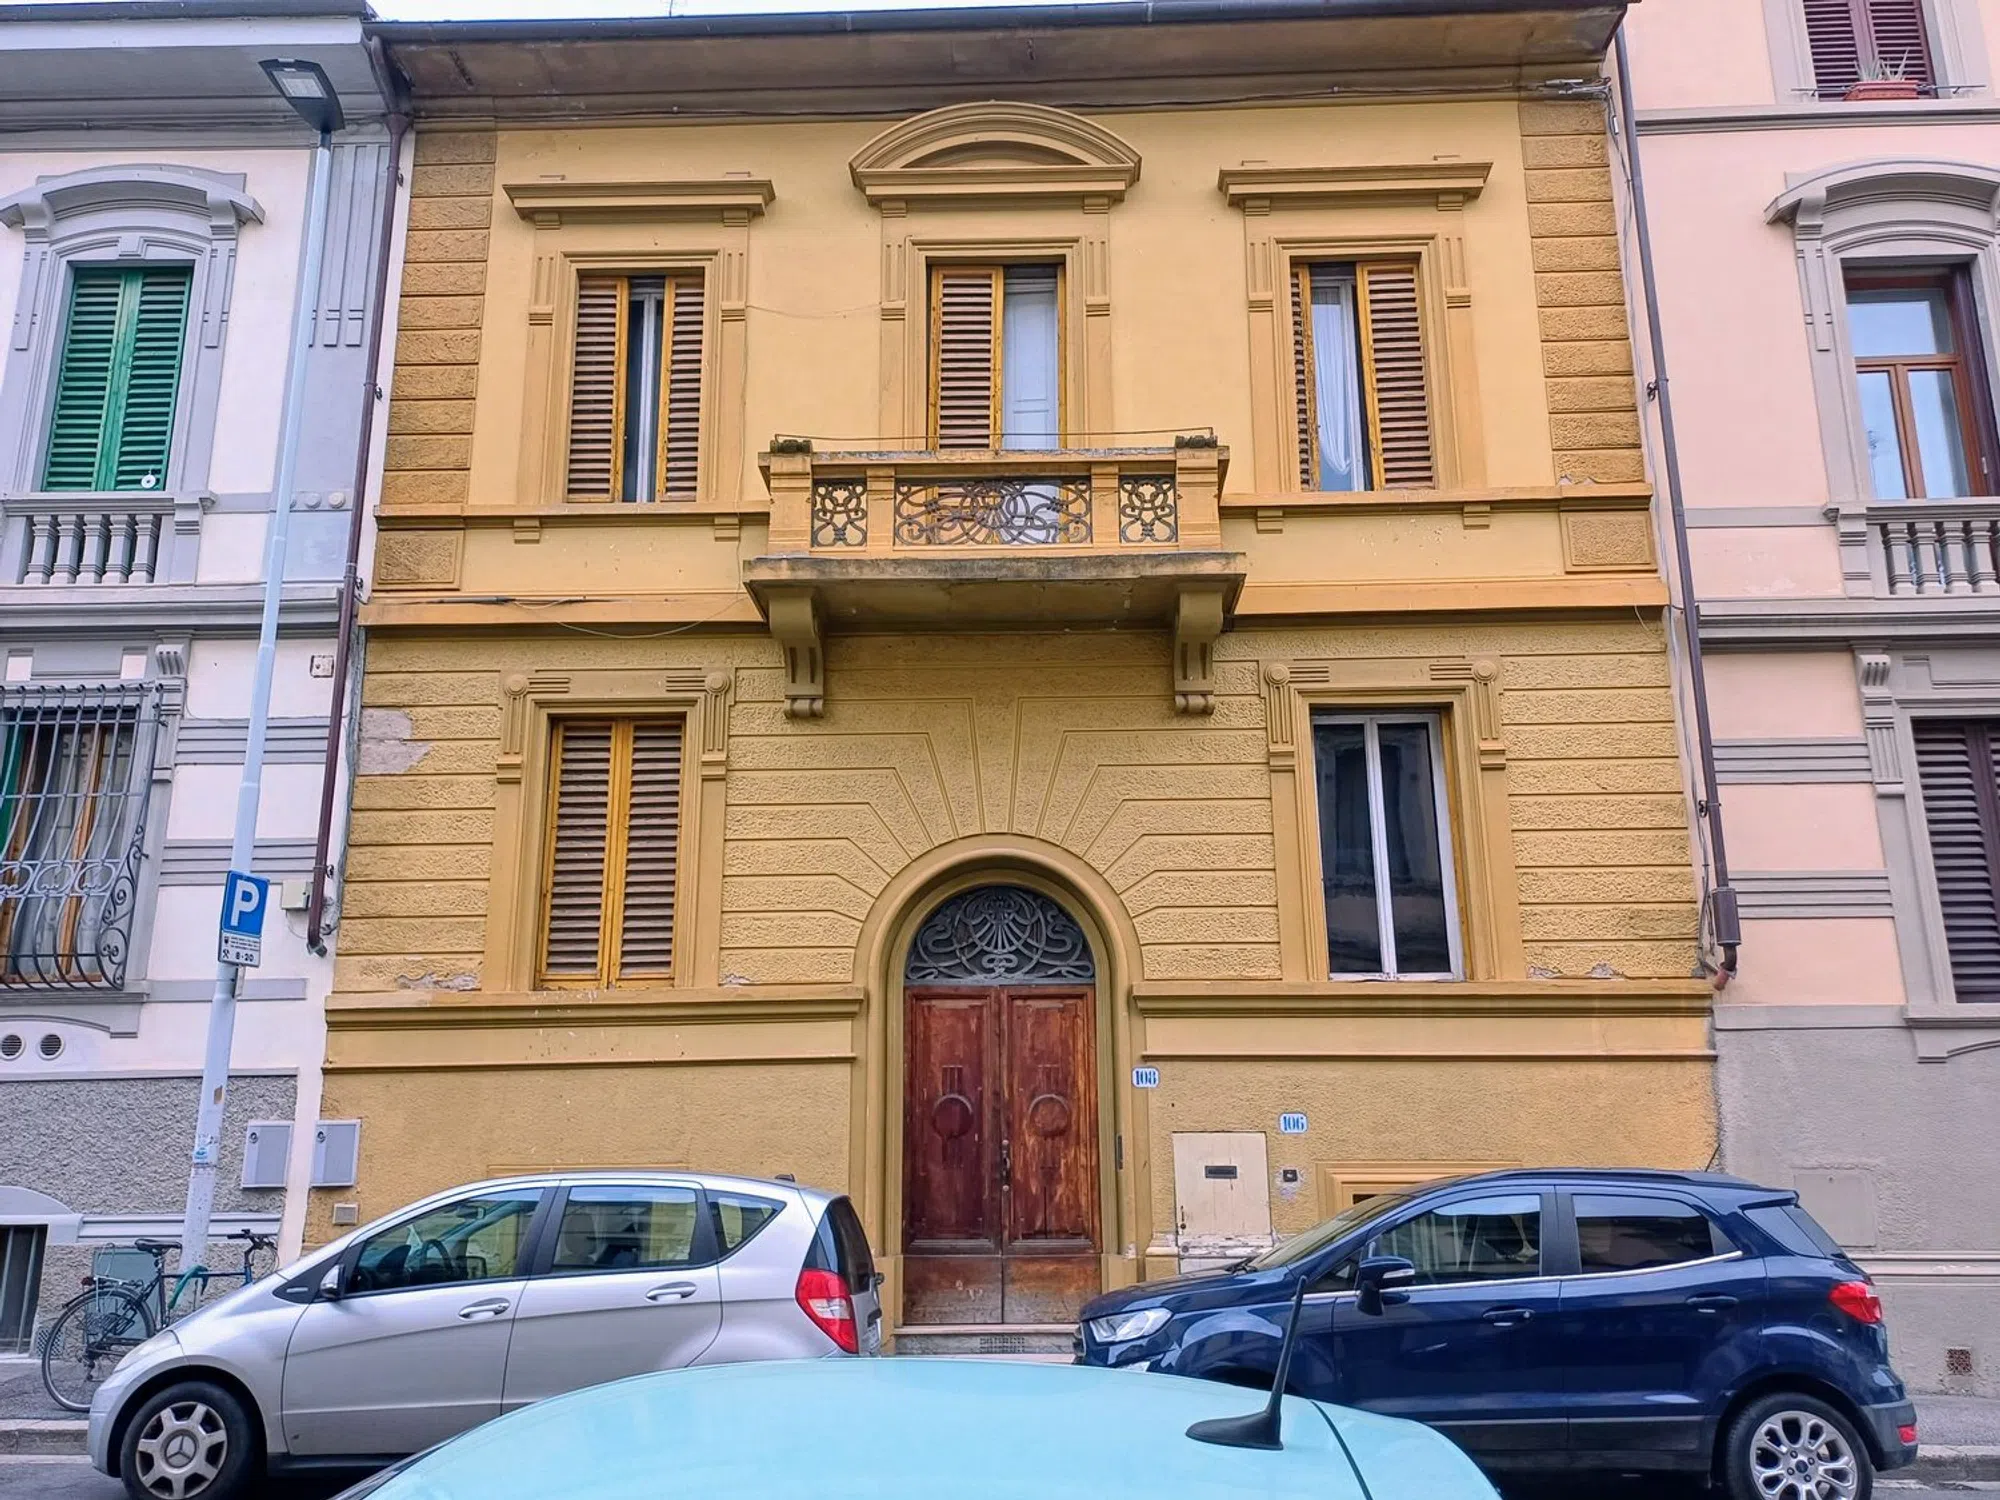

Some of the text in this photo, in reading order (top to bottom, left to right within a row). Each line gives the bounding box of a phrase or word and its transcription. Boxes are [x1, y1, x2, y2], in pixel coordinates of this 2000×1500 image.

[230, 879, 260, 927] P
[1135, 1070, 1157, 1085] 108
[1283, 1116, 1304, 1131] 106
